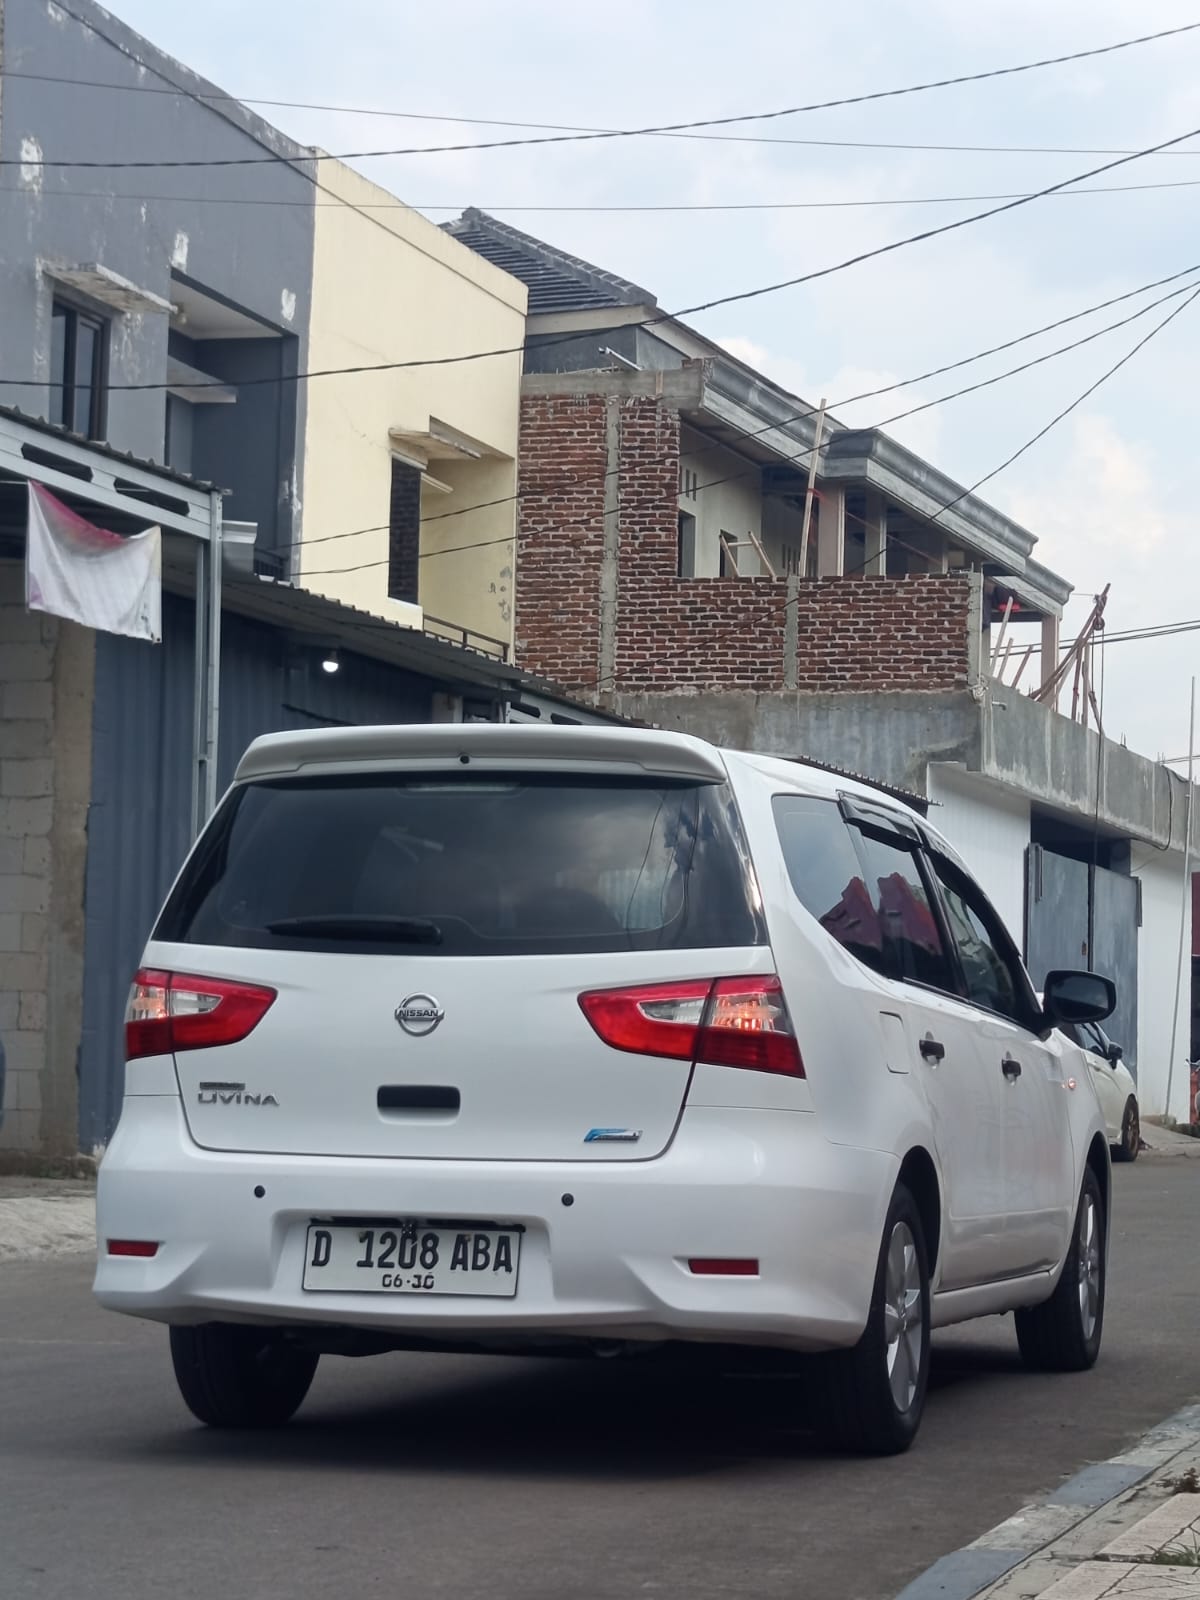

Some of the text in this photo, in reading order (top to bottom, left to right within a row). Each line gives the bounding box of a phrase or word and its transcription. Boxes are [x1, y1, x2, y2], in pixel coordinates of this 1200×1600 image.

[398, 1005, 439, 1017] NISSAN
[311, 1230, 513, 1273] D 1208 ABA
